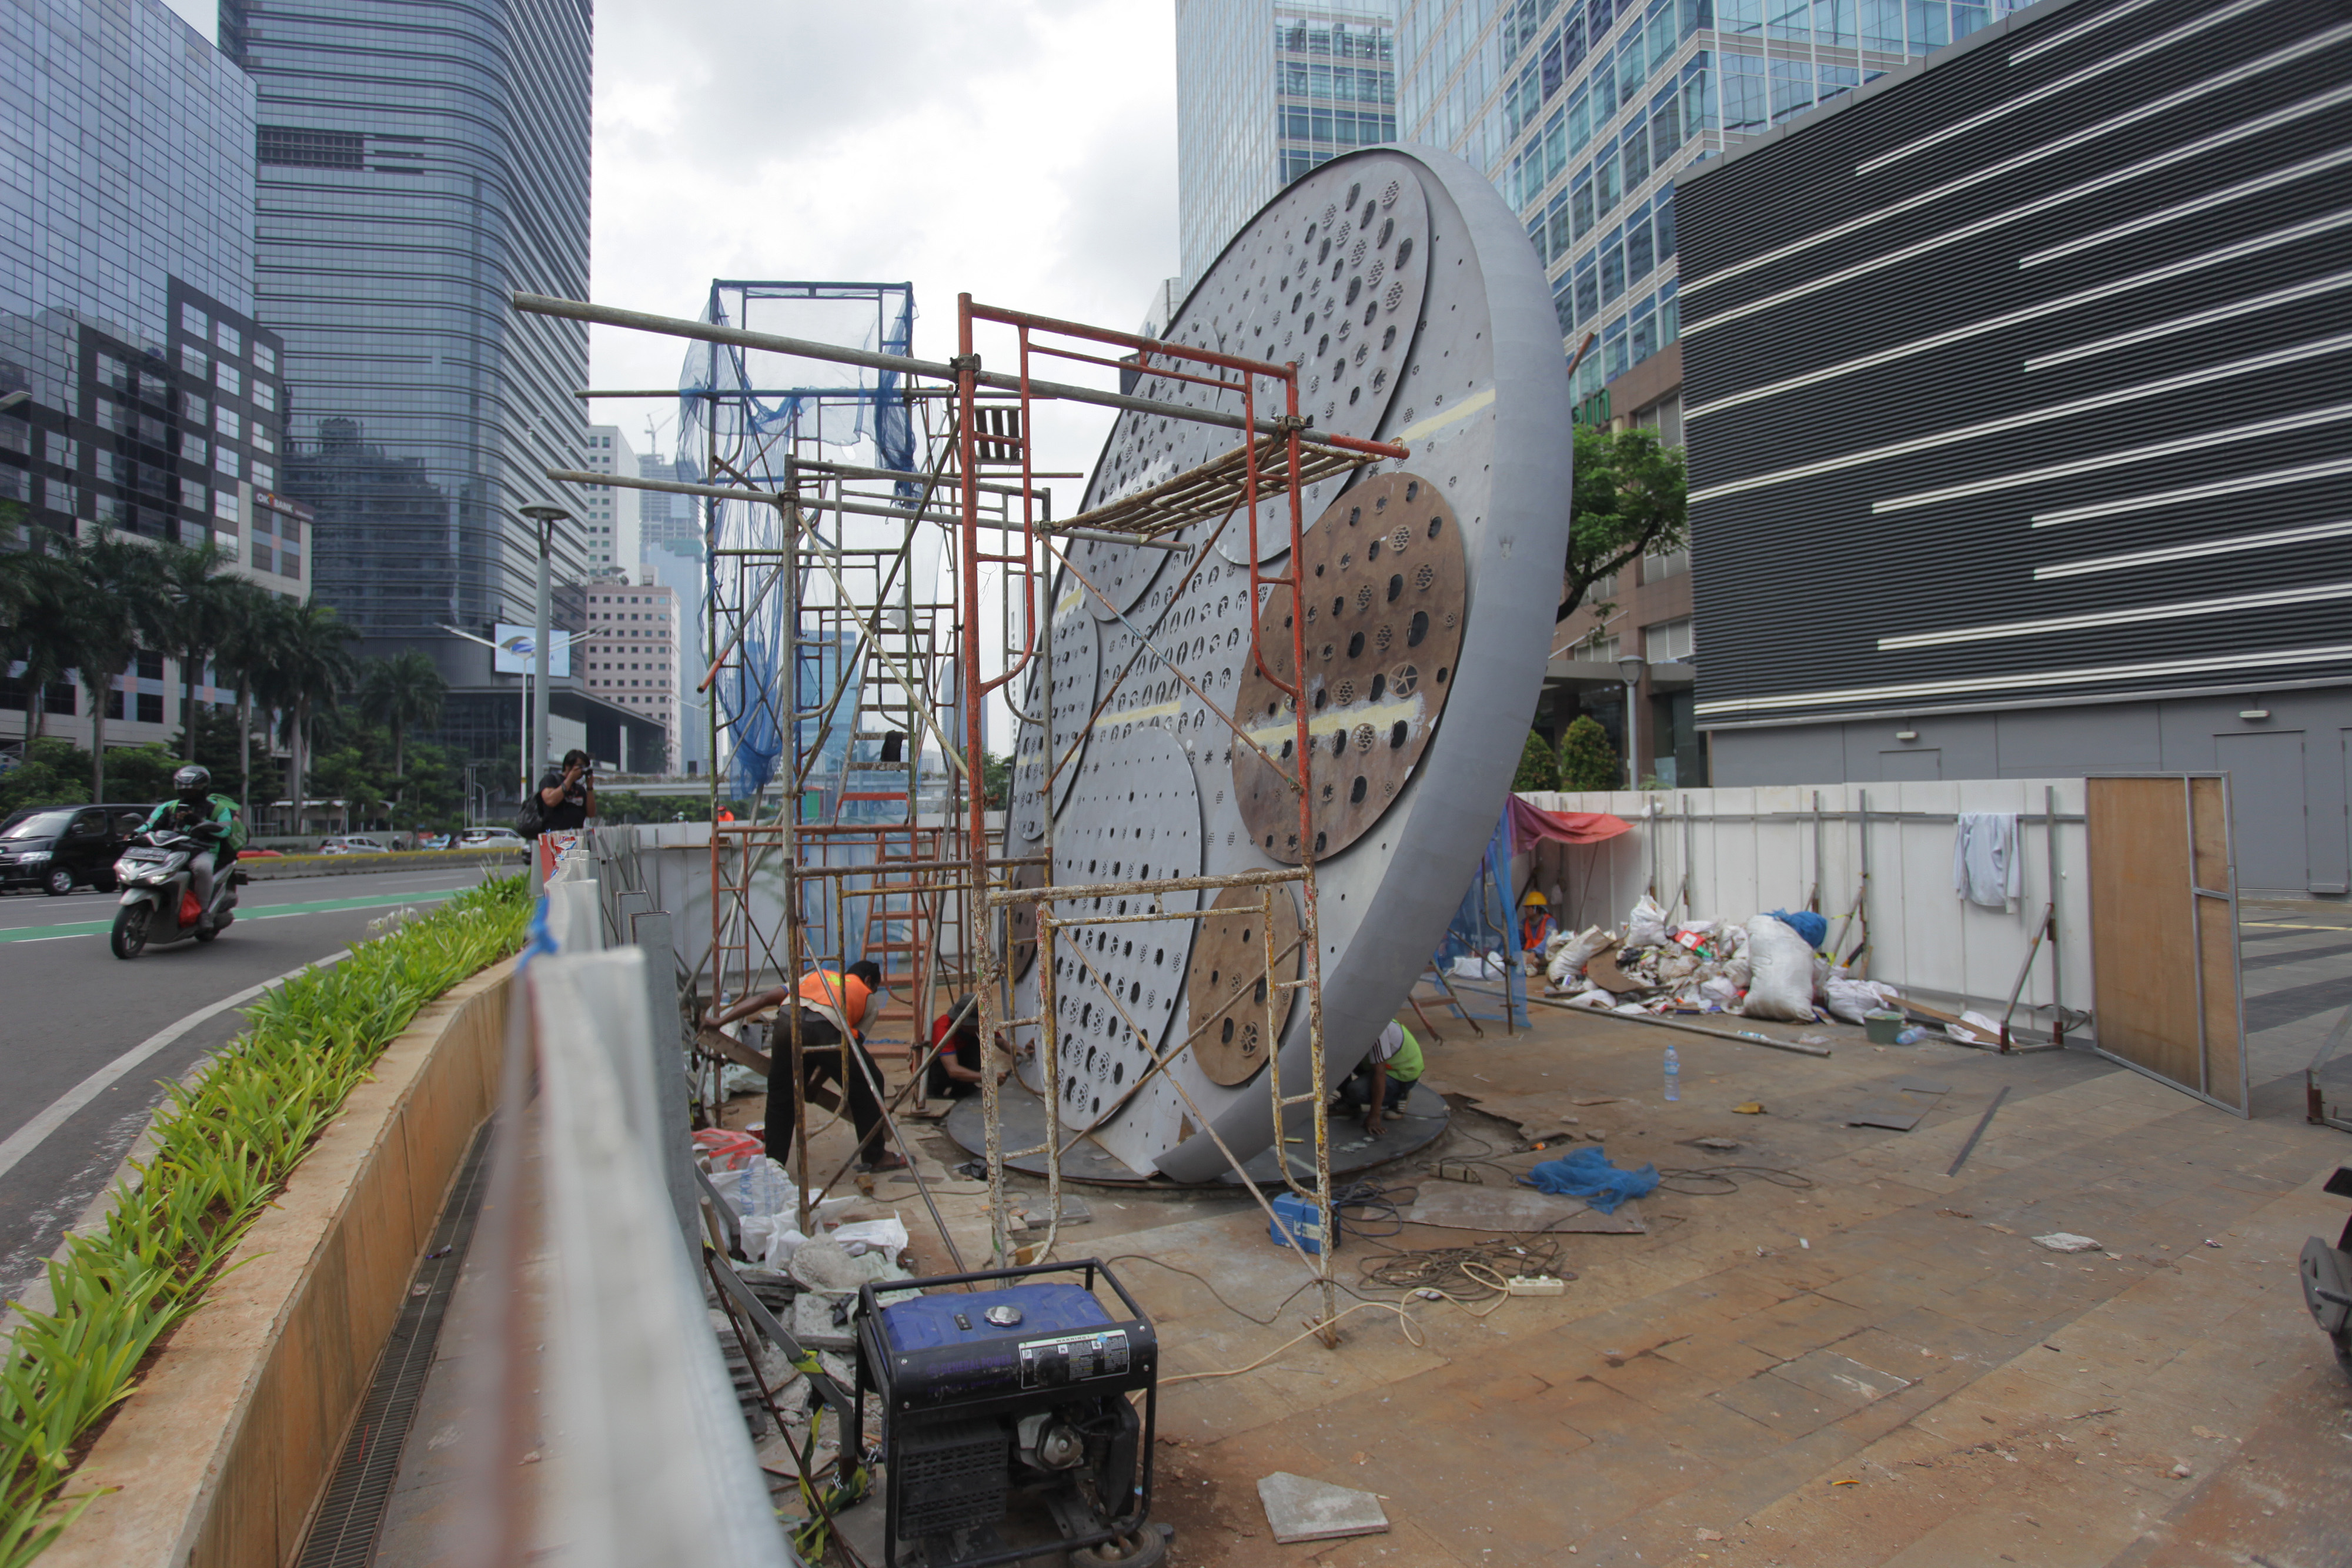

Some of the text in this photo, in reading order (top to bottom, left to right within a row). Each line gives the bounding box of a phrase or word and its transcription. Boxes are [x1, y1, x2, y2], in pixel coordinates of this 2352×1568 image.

[256, 493, 293, 513] OK BANK
[941, 1354, 1012, 1374] GENERAL POWER
